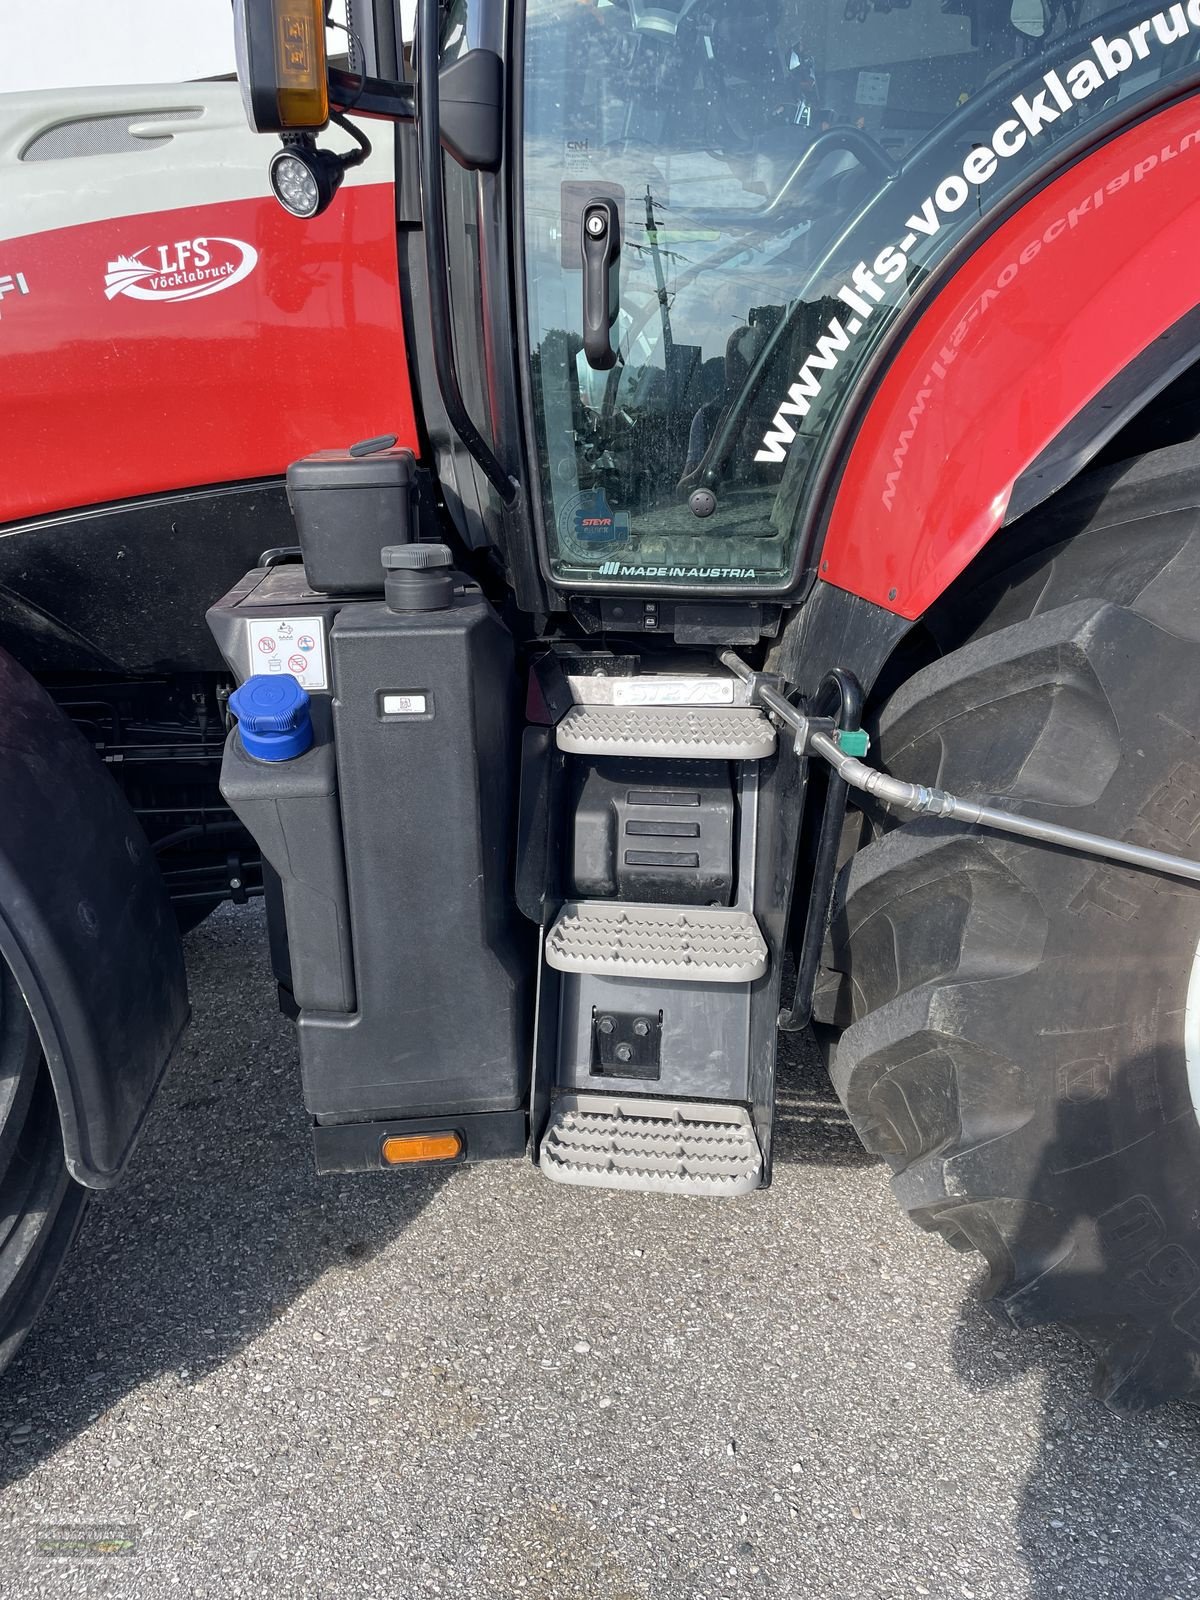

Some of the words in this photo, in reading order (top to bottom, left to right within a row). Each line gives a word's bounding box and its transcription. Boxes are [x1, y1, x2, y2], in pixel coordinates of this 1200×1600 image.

[157, 237, 210, 274] LFS
[150, 262, 235, 290] Vöcklabruck
[581, 518, 612, 526] STEYR
[620, 566, 667, 577] MADE
[669, 567, 685, 577] IN
[687, 567, 756, 578] AUSTRIA
